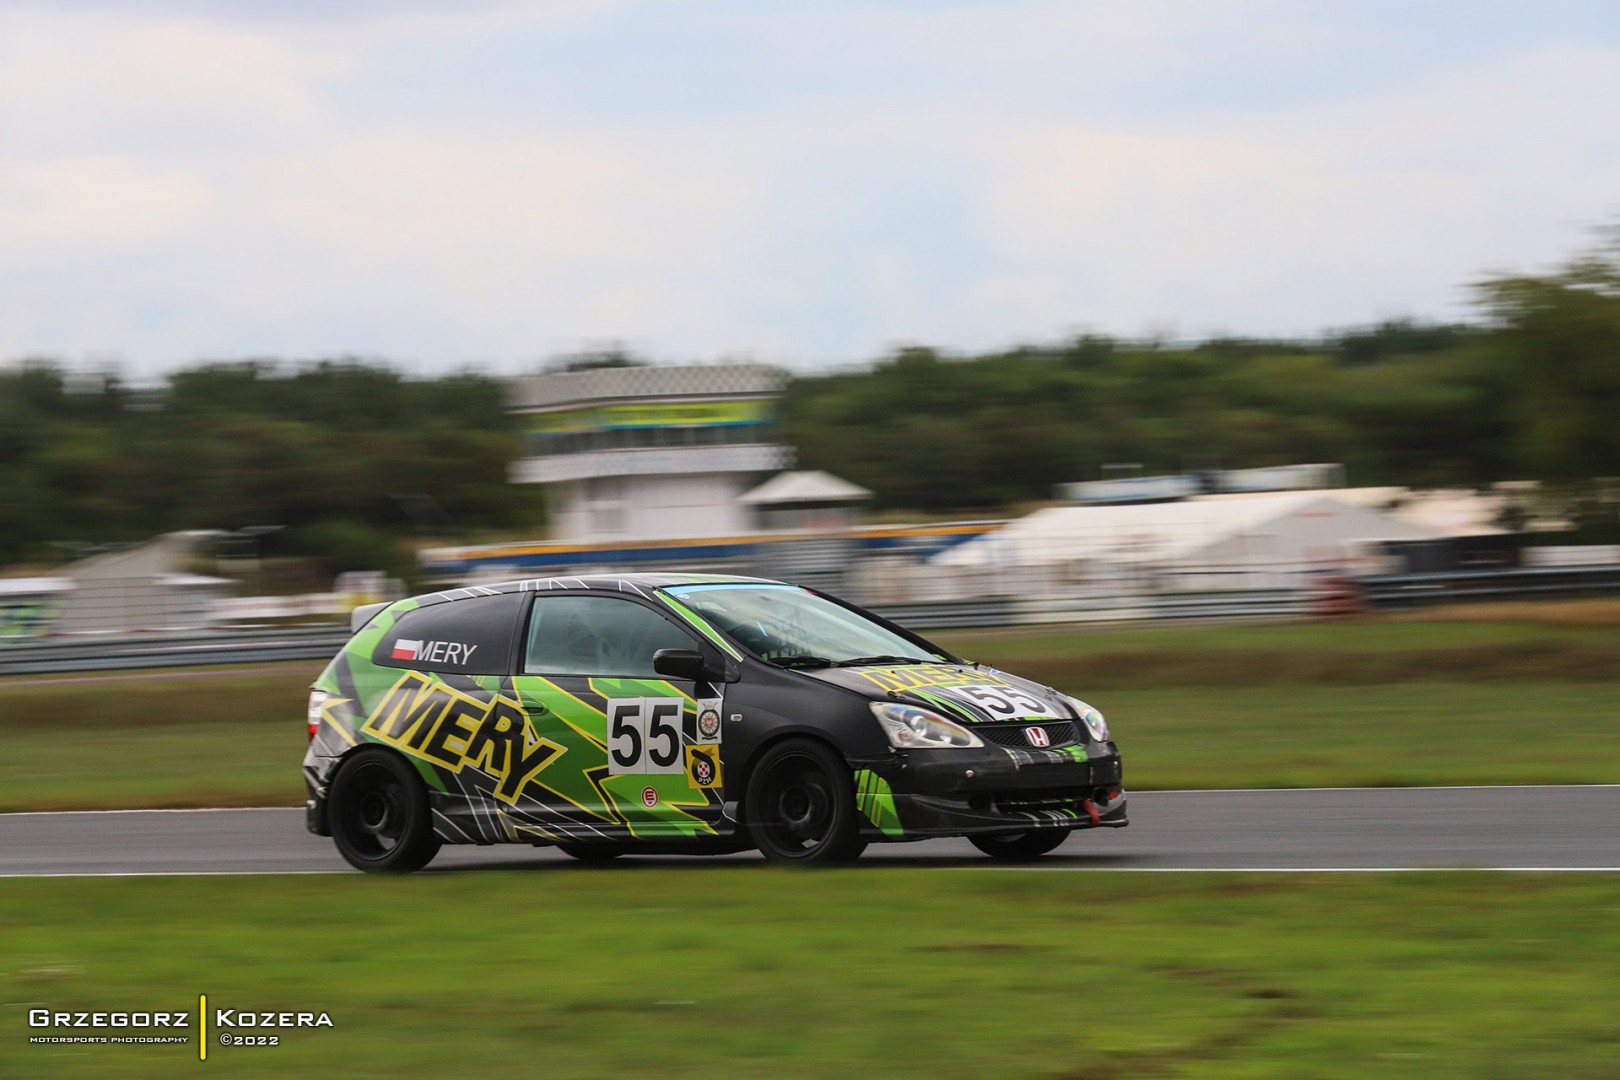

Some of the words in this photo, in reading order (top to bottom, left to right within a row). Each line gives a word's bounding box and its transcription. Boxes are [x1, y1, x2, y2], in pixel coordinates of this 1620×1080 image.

[413, 640, 478, 665] MERY
[960, 686, 1046, 714] 55
[361, 670, 568, 806] MERY
[611, 704, 679, 767] 55
